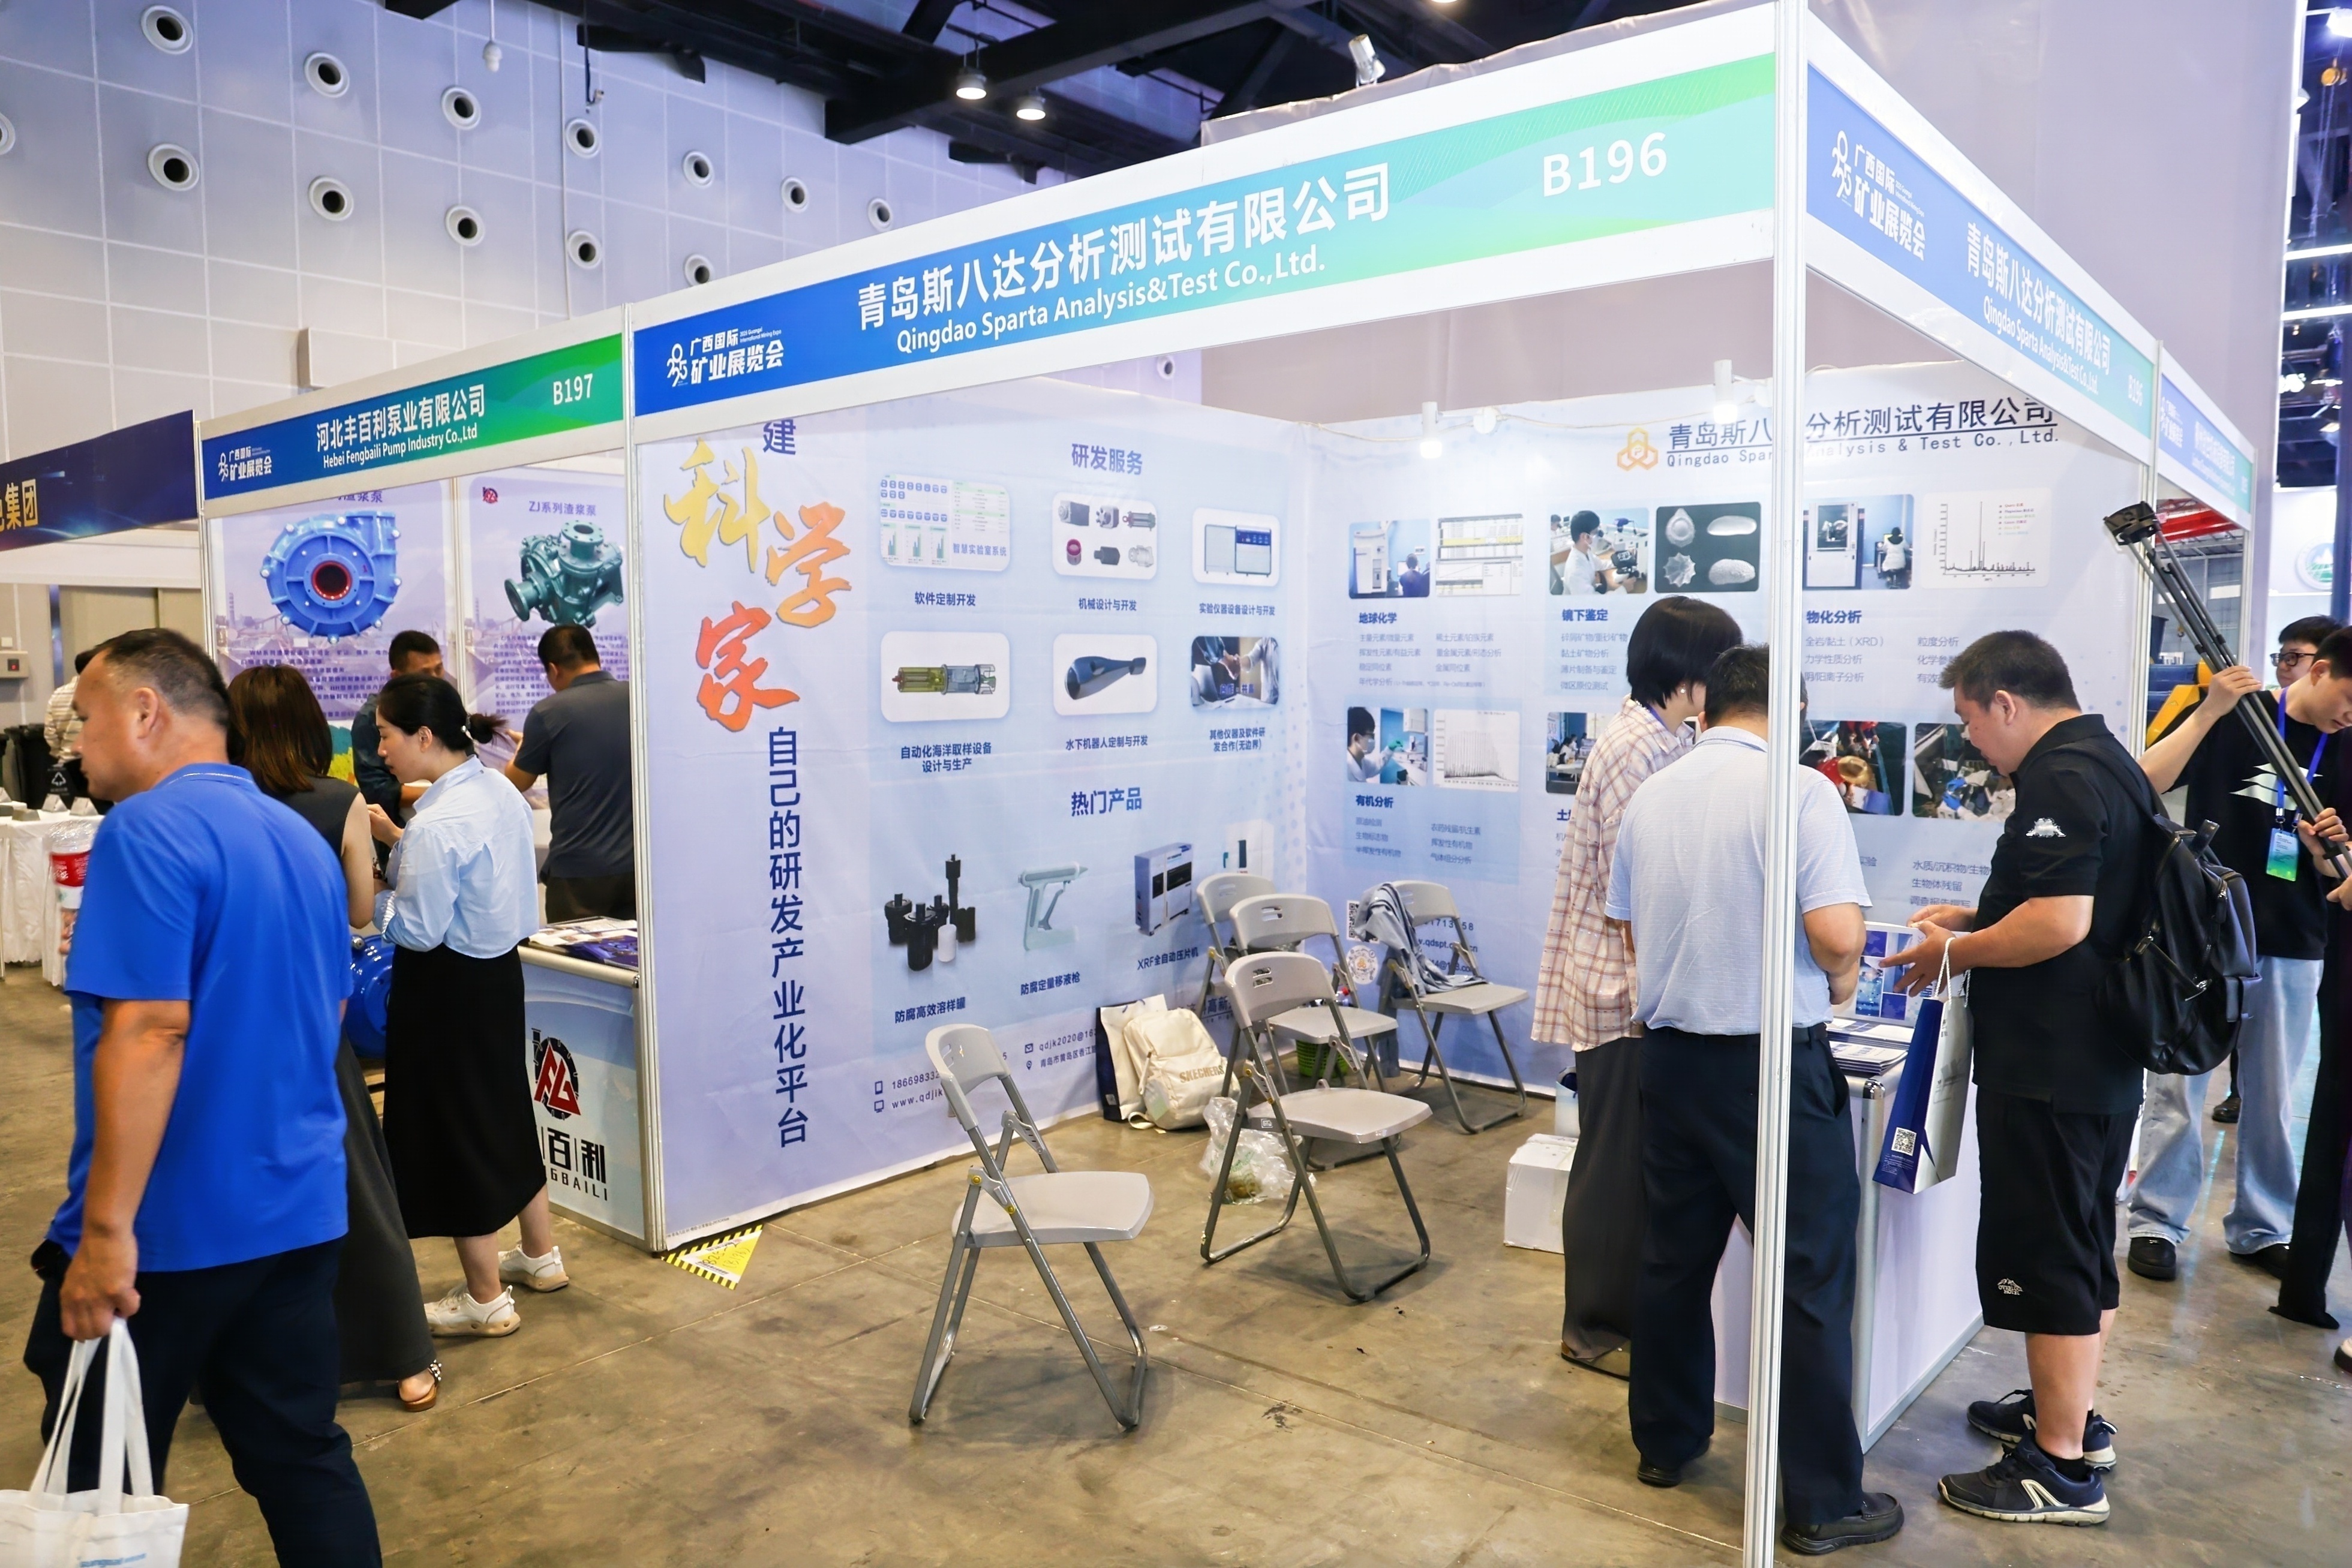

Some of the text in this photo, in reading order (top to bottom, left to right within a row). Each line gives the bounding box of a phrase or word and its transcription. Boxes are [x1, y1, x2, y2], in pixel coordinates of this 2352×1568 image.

[1543, 132, 1667, 197] B196
[1855, 143, 1895, 196] 广西国际
[1854, 175, 1926, 262] 矿业展览会
[858, 161, 1389, 331] 青岛斯八达分析测试有限公司
[897, 244, 1325, 353] Qingdao Sparta Analysis&Test Co.,Ltd.
[1967, 222, 2110, 375] 青岛斯八达分析测试有限公司
[1983, 295, 2016, 337] Qingdao
[2017, 319, 2039, 350] Sparta
[690, 329, 738, 356] 广西国际
[691, 340, 784, 385] 矿业展览会
[553, 374, 593, 405] B197
[316, 384, 485, 452] 河北丰百利泵业有限公司
[1669, 396, 2051, 450] 青岛斯八分析测试有限公司
[323, 423, 477, 468] Hebei Fengbaili Pump Industry Co.,Ltd
[1667, 453, 1729, 467] Qingdao
[1740, 449, 1773, 464] Spar
[1899, 438, 1908, 451] &
[1920, 436, 1961, 450] Test
[230, 455, 272, 481] 矿业展览会
[1071, 443, 1143, 475] 研发服务
[528, 500, 597, 516] ZJ系列渣浆泵
[953, 542, 1007, 557] 智慧实验室系统
[915, 591, 976, 606] 软件定制开发
[1079, 598, 1137, 611] 机械设计与开发
[1199, 603, 1275, 615] 实验仪器设备设计与开发
[1359, 612, 1397, 624] 地球化学
[1562, 608, 1608, 622] 镜下鉴定
[1806, 610, 1862, 624] 物化分析
[1918, 636, 1959, 647] 粒度分析
[1917, 673, 1939, 684] 有效
[1065, 735, 1148, 750] 水下机器人定制与开发
[1209, 727, 1265, 740] 其他仪器及软件研
[900, 741, 992, 759] 自动化海洋取样设备
[922, 758, 972, 773] 设计与生产
[1071, 787, 1142, 816] 热门产品
[1356, 795, 1394, 808] 有机分析
[1913, 860, 1991, 875] 水质/沉积物/生物
[1912, 878, 1962, 891] 生物体残留
[768, 726, 809, 1148] 自己的研发产业化平台
[1137, 946, 1199, 971] XRF全自动压片机
[1020, 971, 1080, 996] 防腐定量移液枪
[894, 996, 966, 1023] 防腐高效溶样罐
[1039, 1029, 1096, 1051] qdjk2020@16
[892, 1071, 941, 1089] 186698332
[1179, 1064, 1225, 1083] SKECHERS
[547, 1127, 606, 1183] 百利
[551, 1167, 607, 1201] GBAILI
